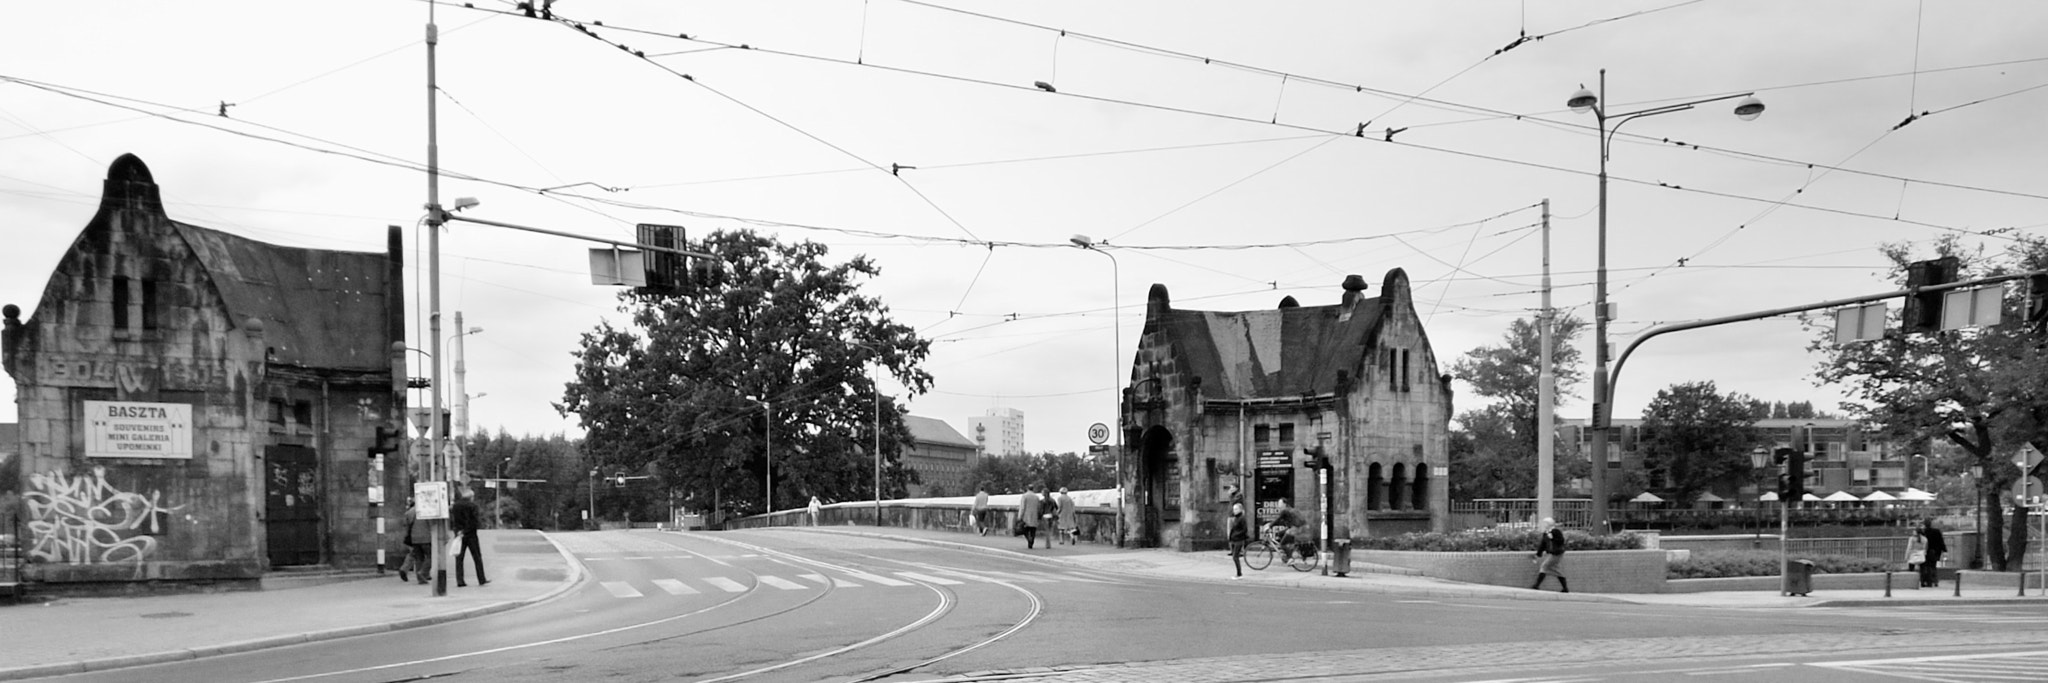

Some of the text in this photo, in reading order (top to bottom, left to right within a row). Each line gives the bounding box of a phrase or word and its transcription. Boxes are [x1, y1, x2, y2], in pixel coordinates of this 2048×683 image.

[108, 405, 167, 419] BASZTA
[113, 423, 165, 432] SOUVENIRS
[108, 433, 170, 442] MINI GALERIA
[116, 443, 162, 451] UPOMINKI
